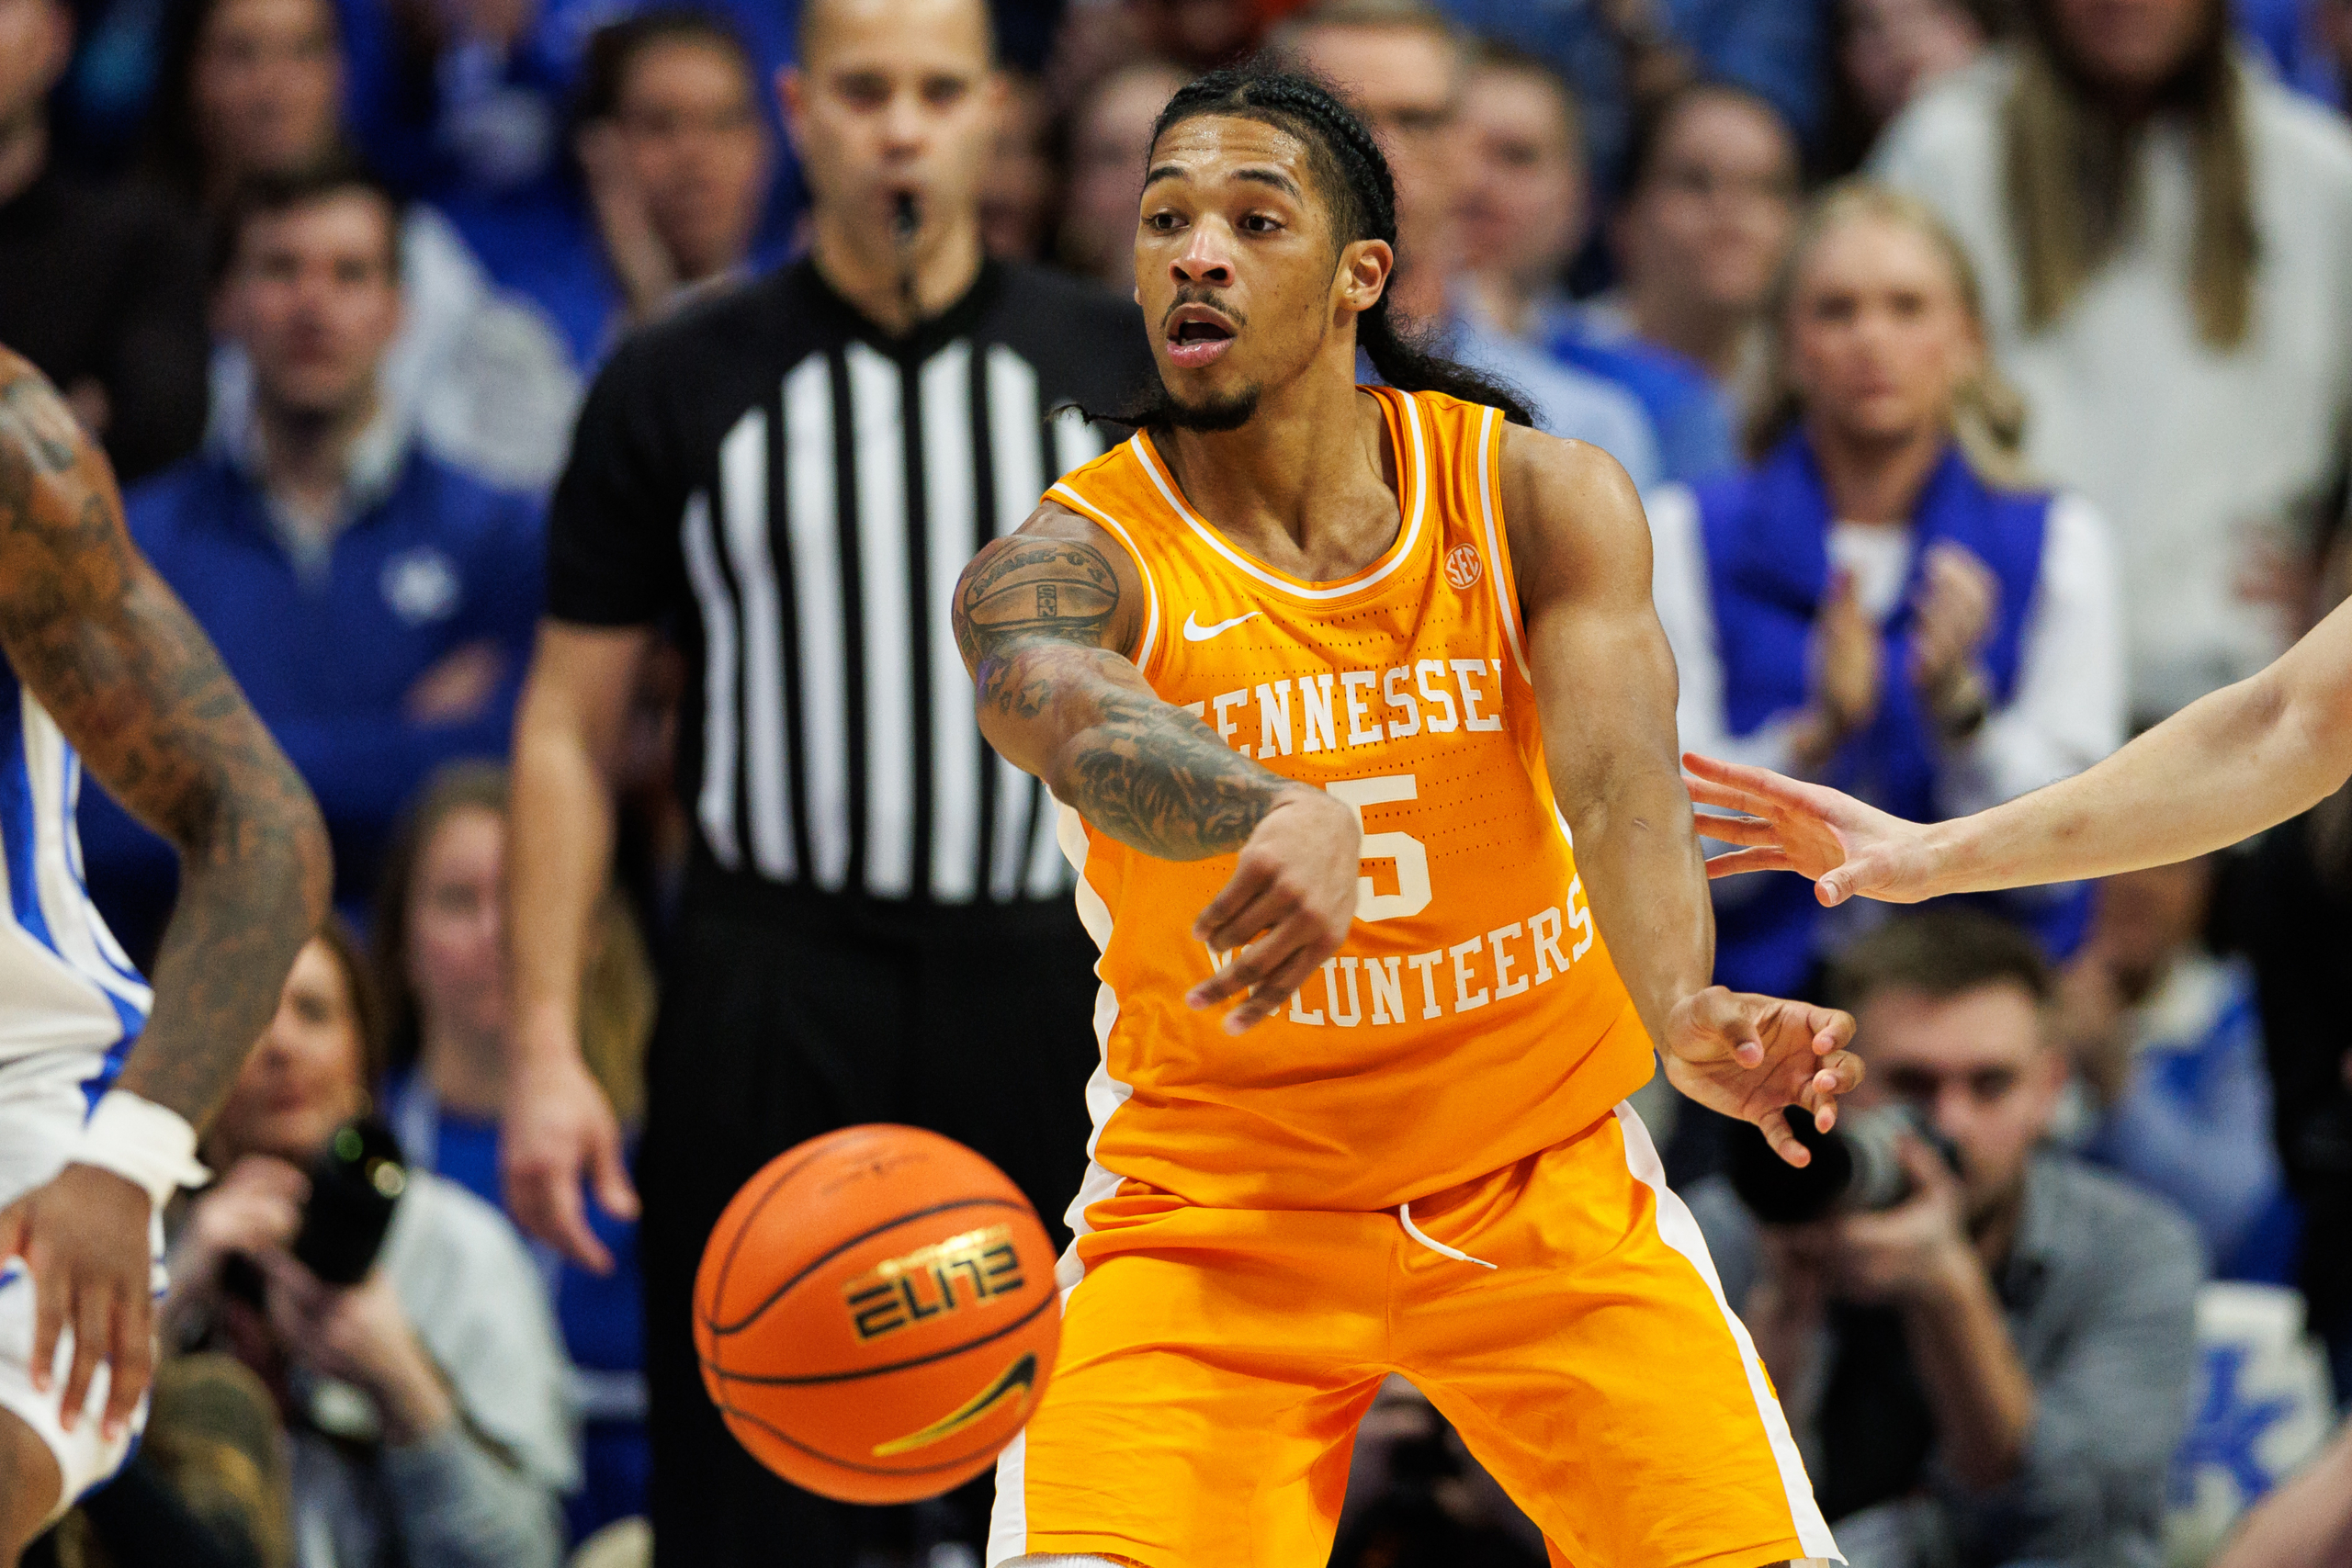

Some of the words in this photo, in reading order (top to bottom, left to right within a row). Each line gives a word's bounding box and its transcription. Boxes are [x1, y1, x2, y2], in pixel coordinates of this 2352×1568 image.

[1445, 546, 1480, 586] SEC
[1181, 657, 1503, 761] ENNESSE
[1325, 773, 1433, 922] 5
[1204, 872, 1596, 1028] LUNTEERS
[844, 1232, 1026, 1342] ELITE
